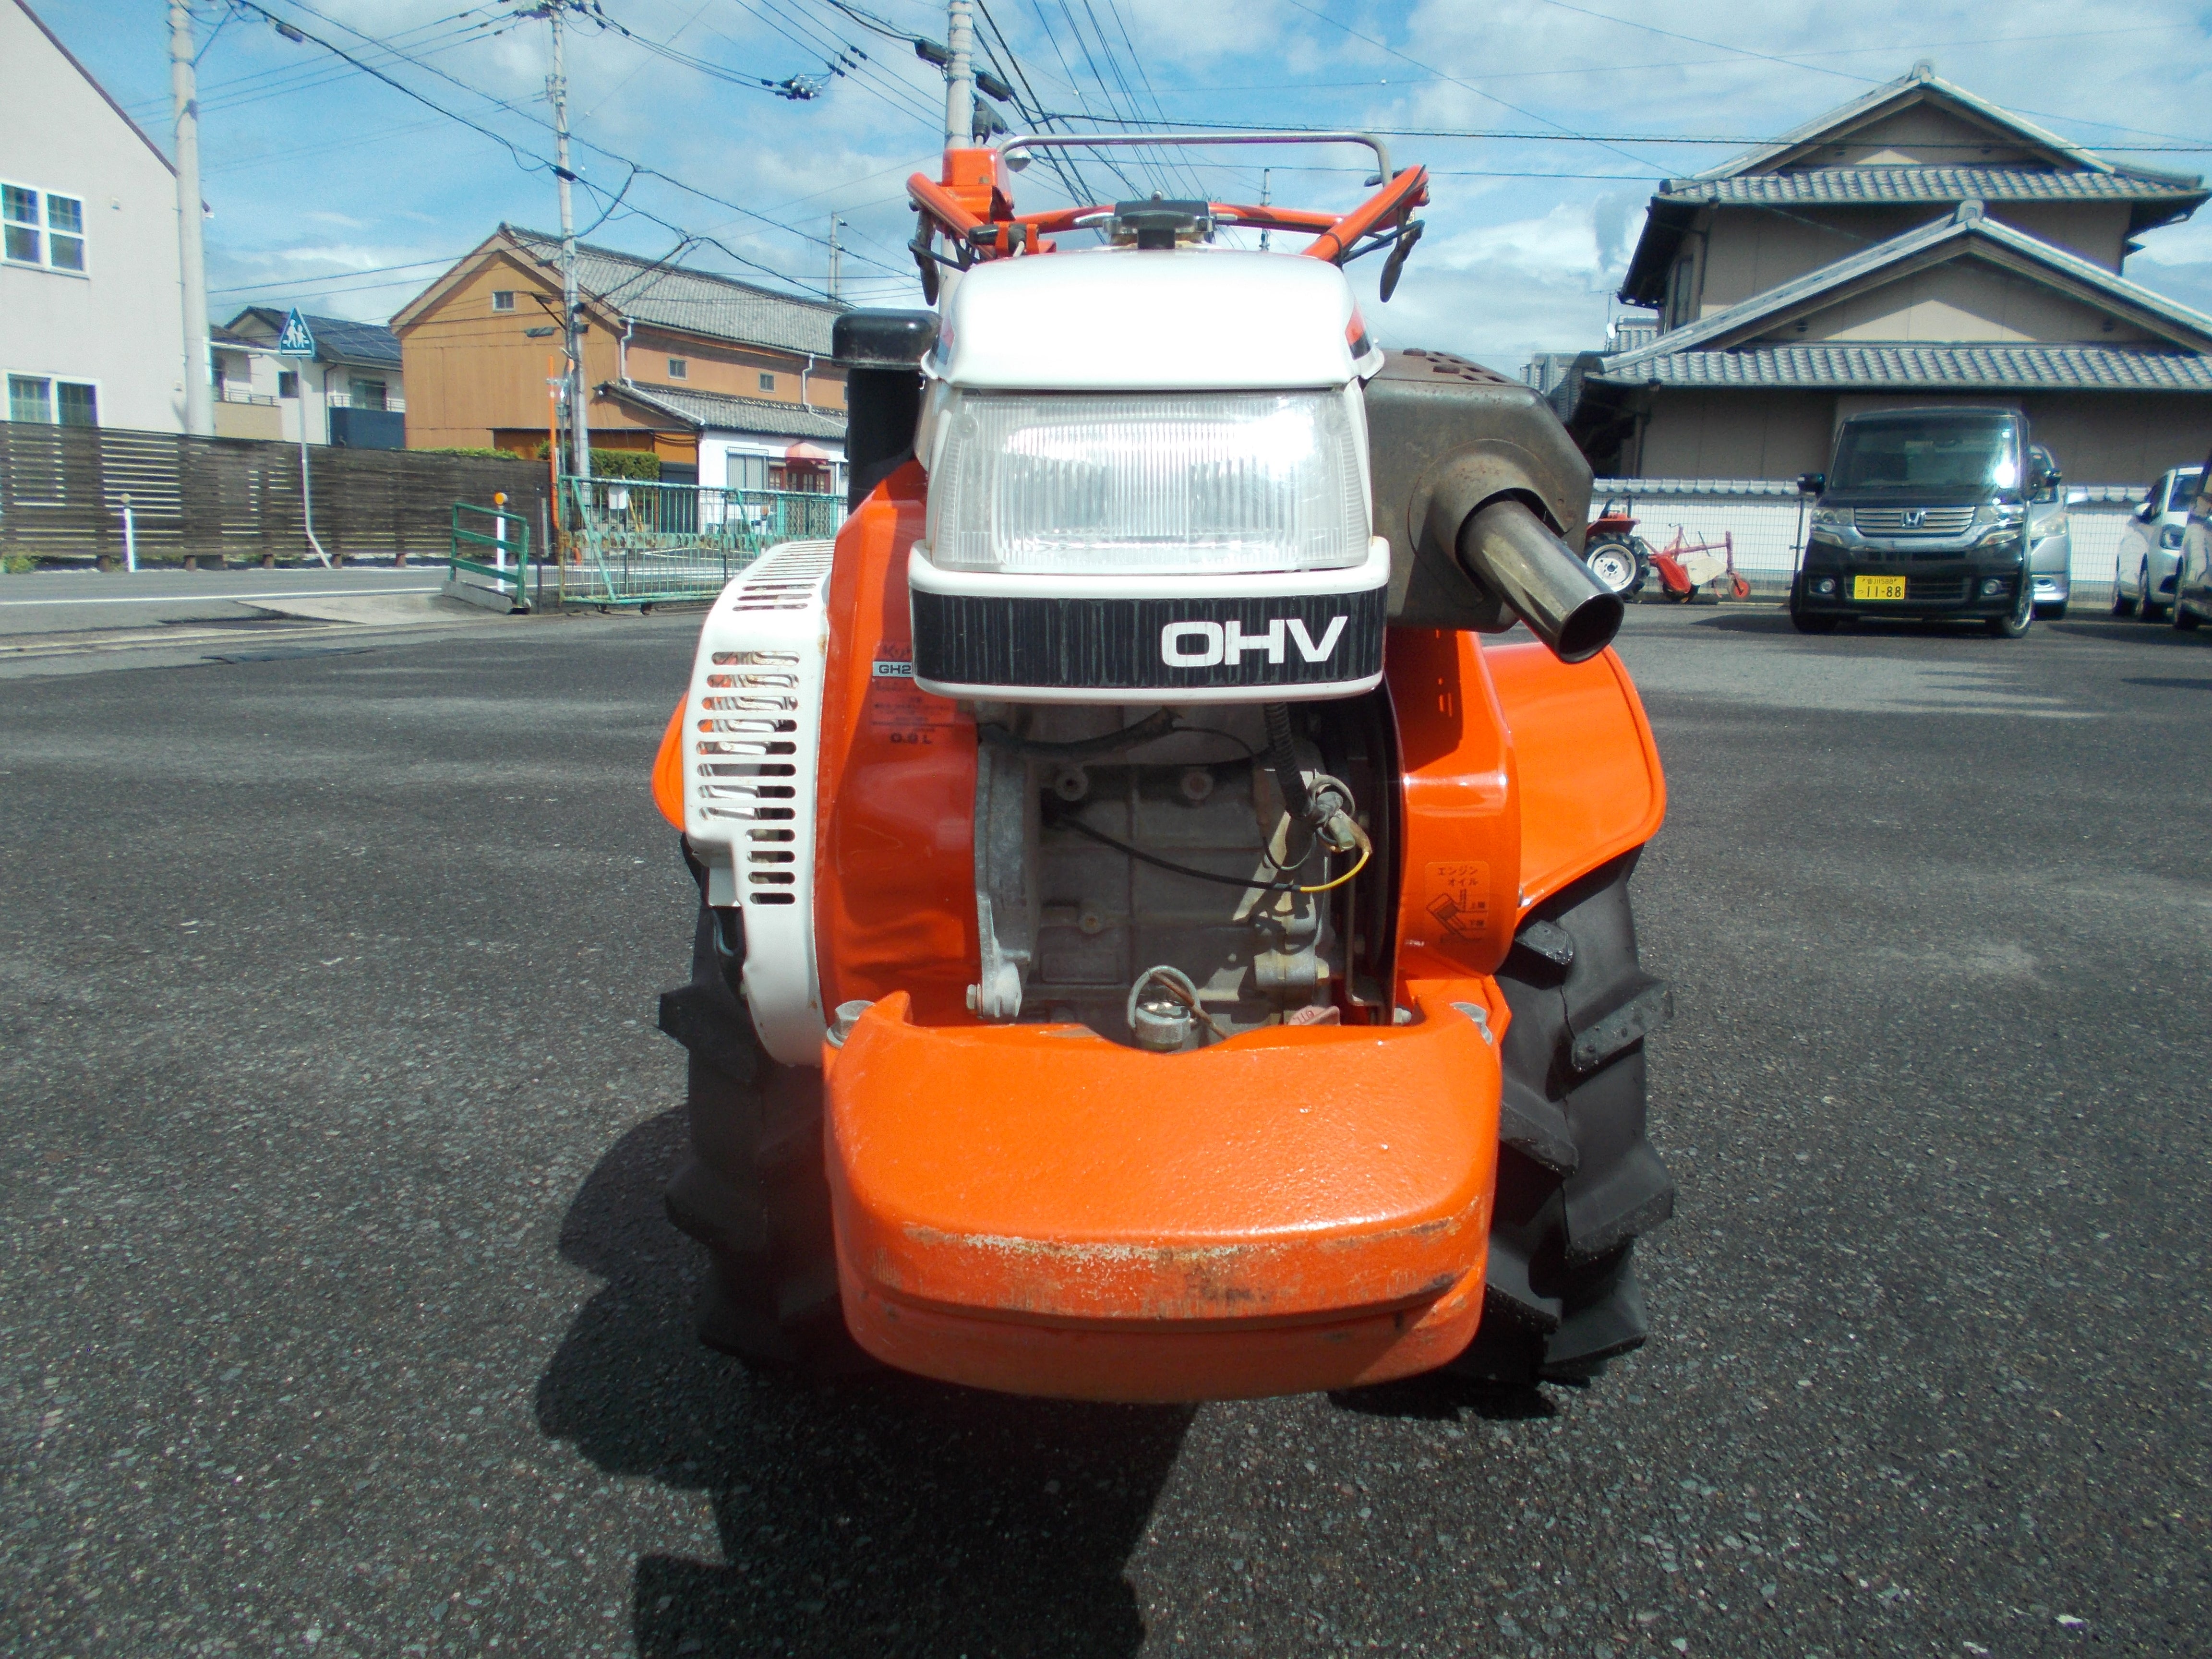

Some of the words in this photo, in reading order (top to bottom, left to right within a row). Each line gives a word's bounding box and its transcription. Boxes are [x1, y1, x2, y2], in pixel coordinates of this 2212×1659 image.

[1867, 586, 1901, 598] 11-88
[1161, 616, 1348, 667] OHV
[1437, 865, 1478, 876] エンジン
[1448, 878, 1479, 887] オイル
